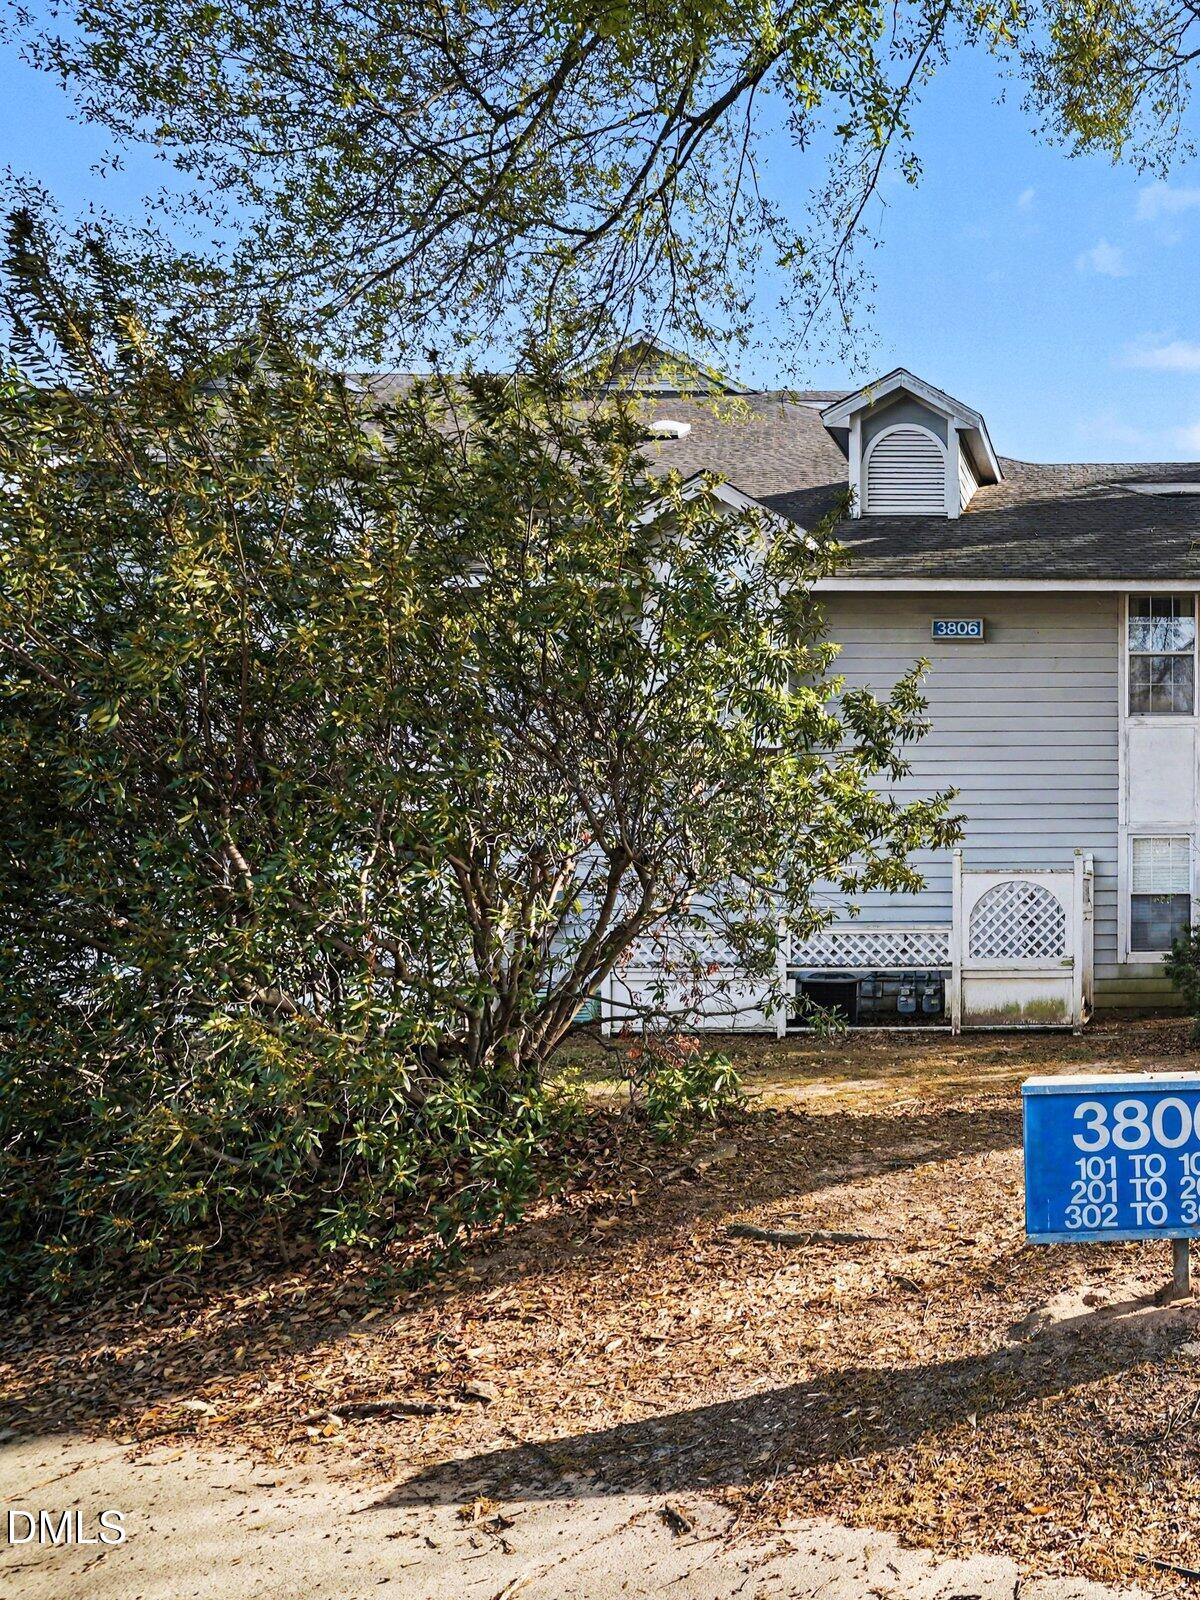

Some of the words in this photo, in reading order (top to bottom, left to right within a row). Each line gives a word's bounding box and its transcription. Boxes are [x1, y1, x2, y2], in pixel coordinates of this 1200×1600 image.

[937, 622, 979, 635] 3806
[1075, 1156, 1117, 1181] 101
[1128, 1153, 1166, 1179] TO
[1070, 1179, 1118, 1204] 201
[1129, 1177, 1167, 1202] TO
[1064, 1203, 1118, 1229] 302
[1130, 1201, 1168, 1226] TO
